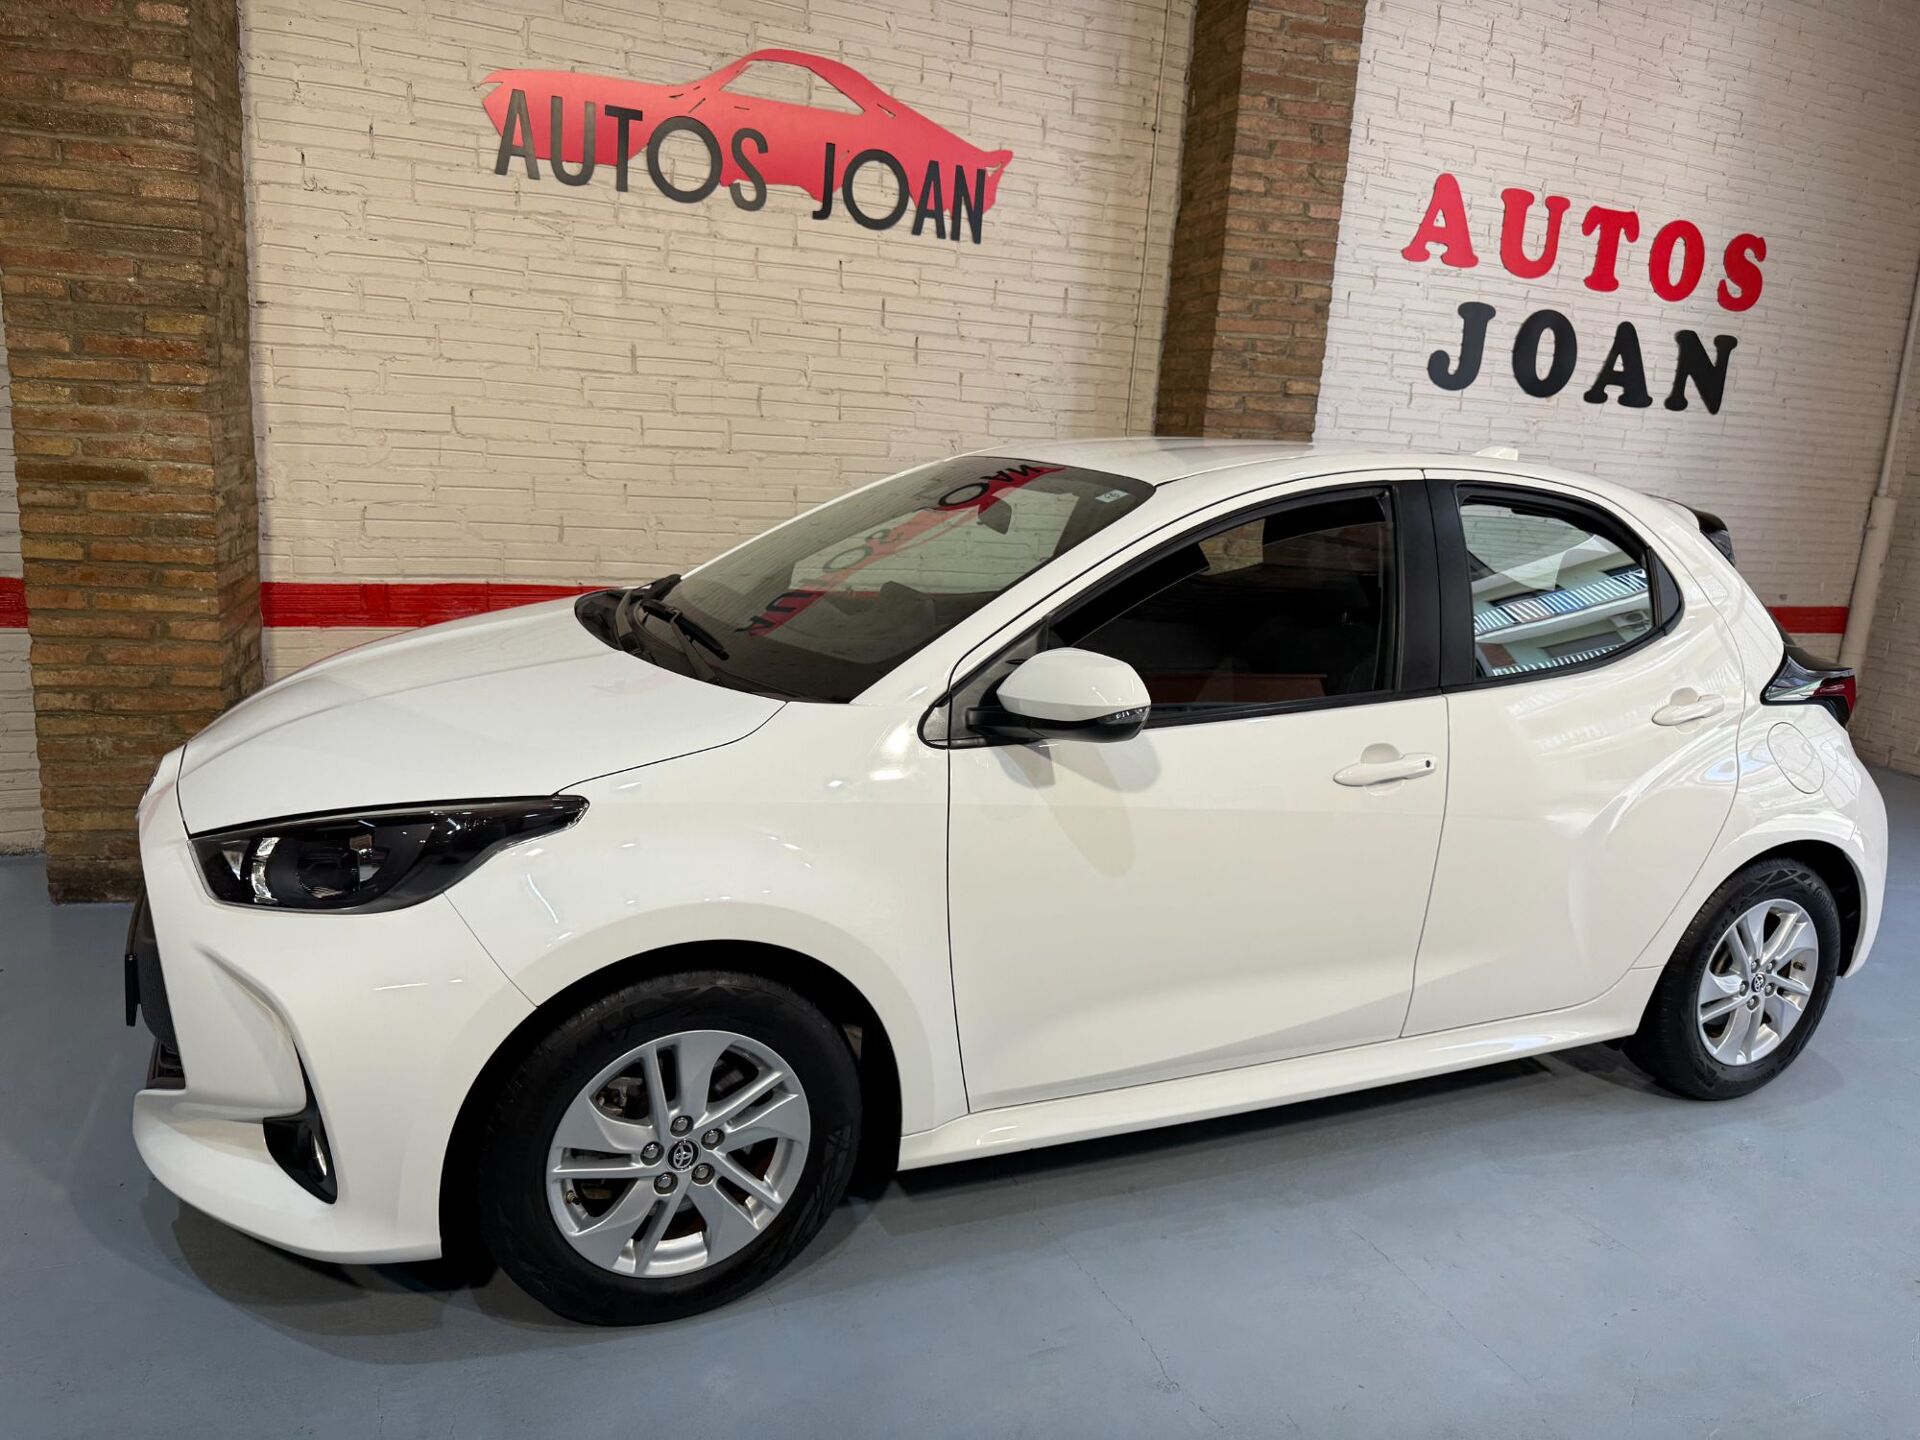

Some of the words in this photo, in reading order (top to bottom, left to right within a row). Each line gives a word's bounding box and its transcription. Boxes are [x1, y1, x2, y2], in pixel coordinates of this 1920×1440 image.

[495, 89, 768, 211] AUTOS
[812, 143, 986, 244] JOAN
[1401, 173, 1766, 312] AUTOS
[1427, 302, 1738, 415] JOAN
